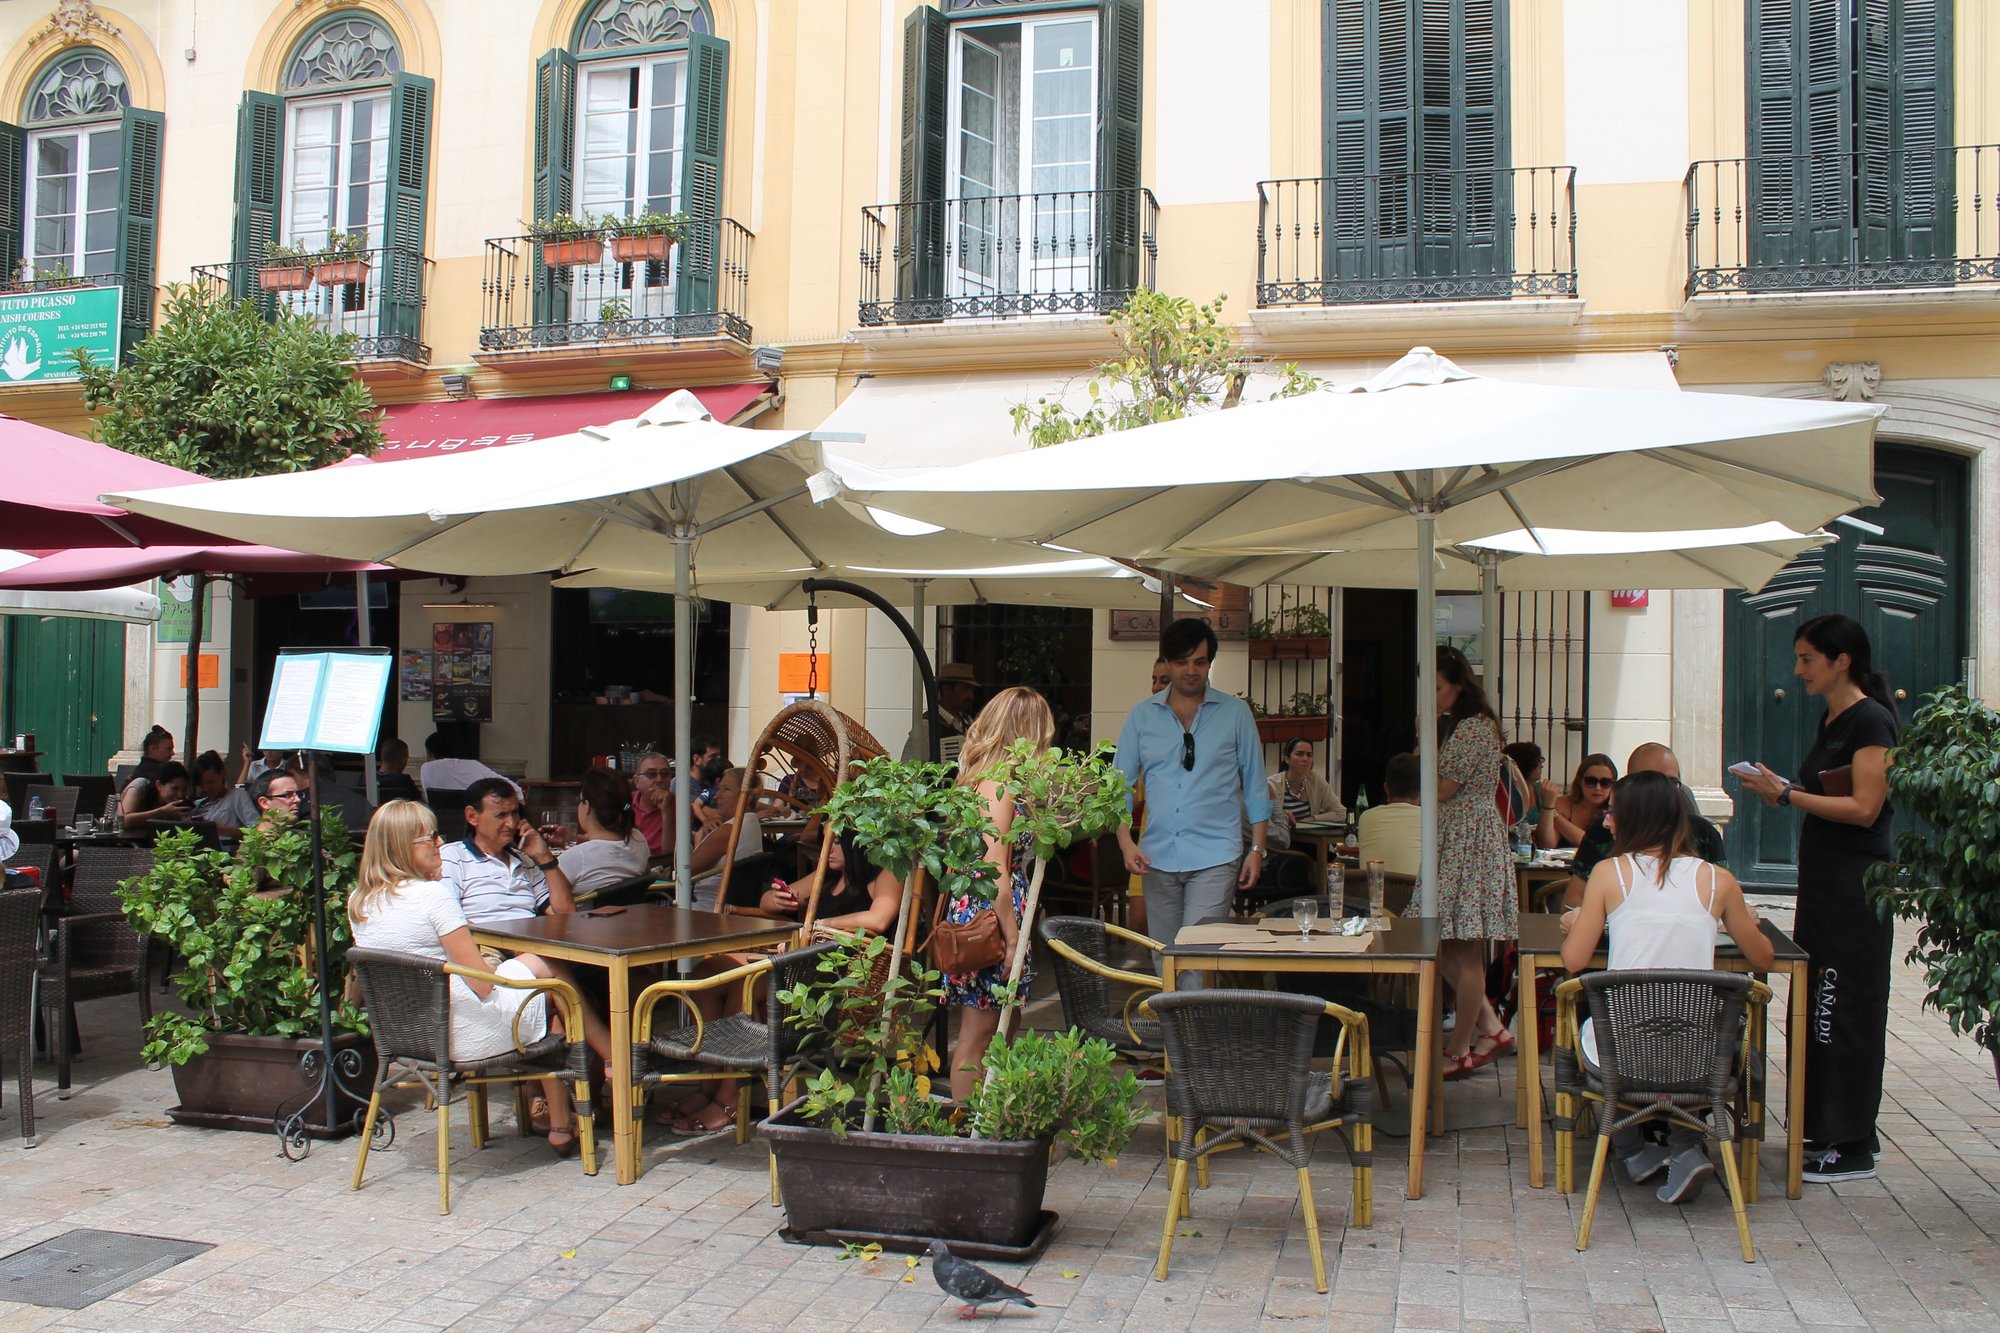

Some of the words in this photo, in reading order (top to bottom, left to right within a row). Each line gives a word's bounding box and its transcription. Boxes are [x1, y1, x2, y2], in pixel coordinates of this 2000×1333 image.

[31, 294, 76, 308] PICASSO
[0, 313, 20, 323] NISH
[23, 310, 61, 322] COURSES
[1128, 614, 1229, 629] CADÚ
[1819, 968, 1837, 1044] CAÑADÚ
